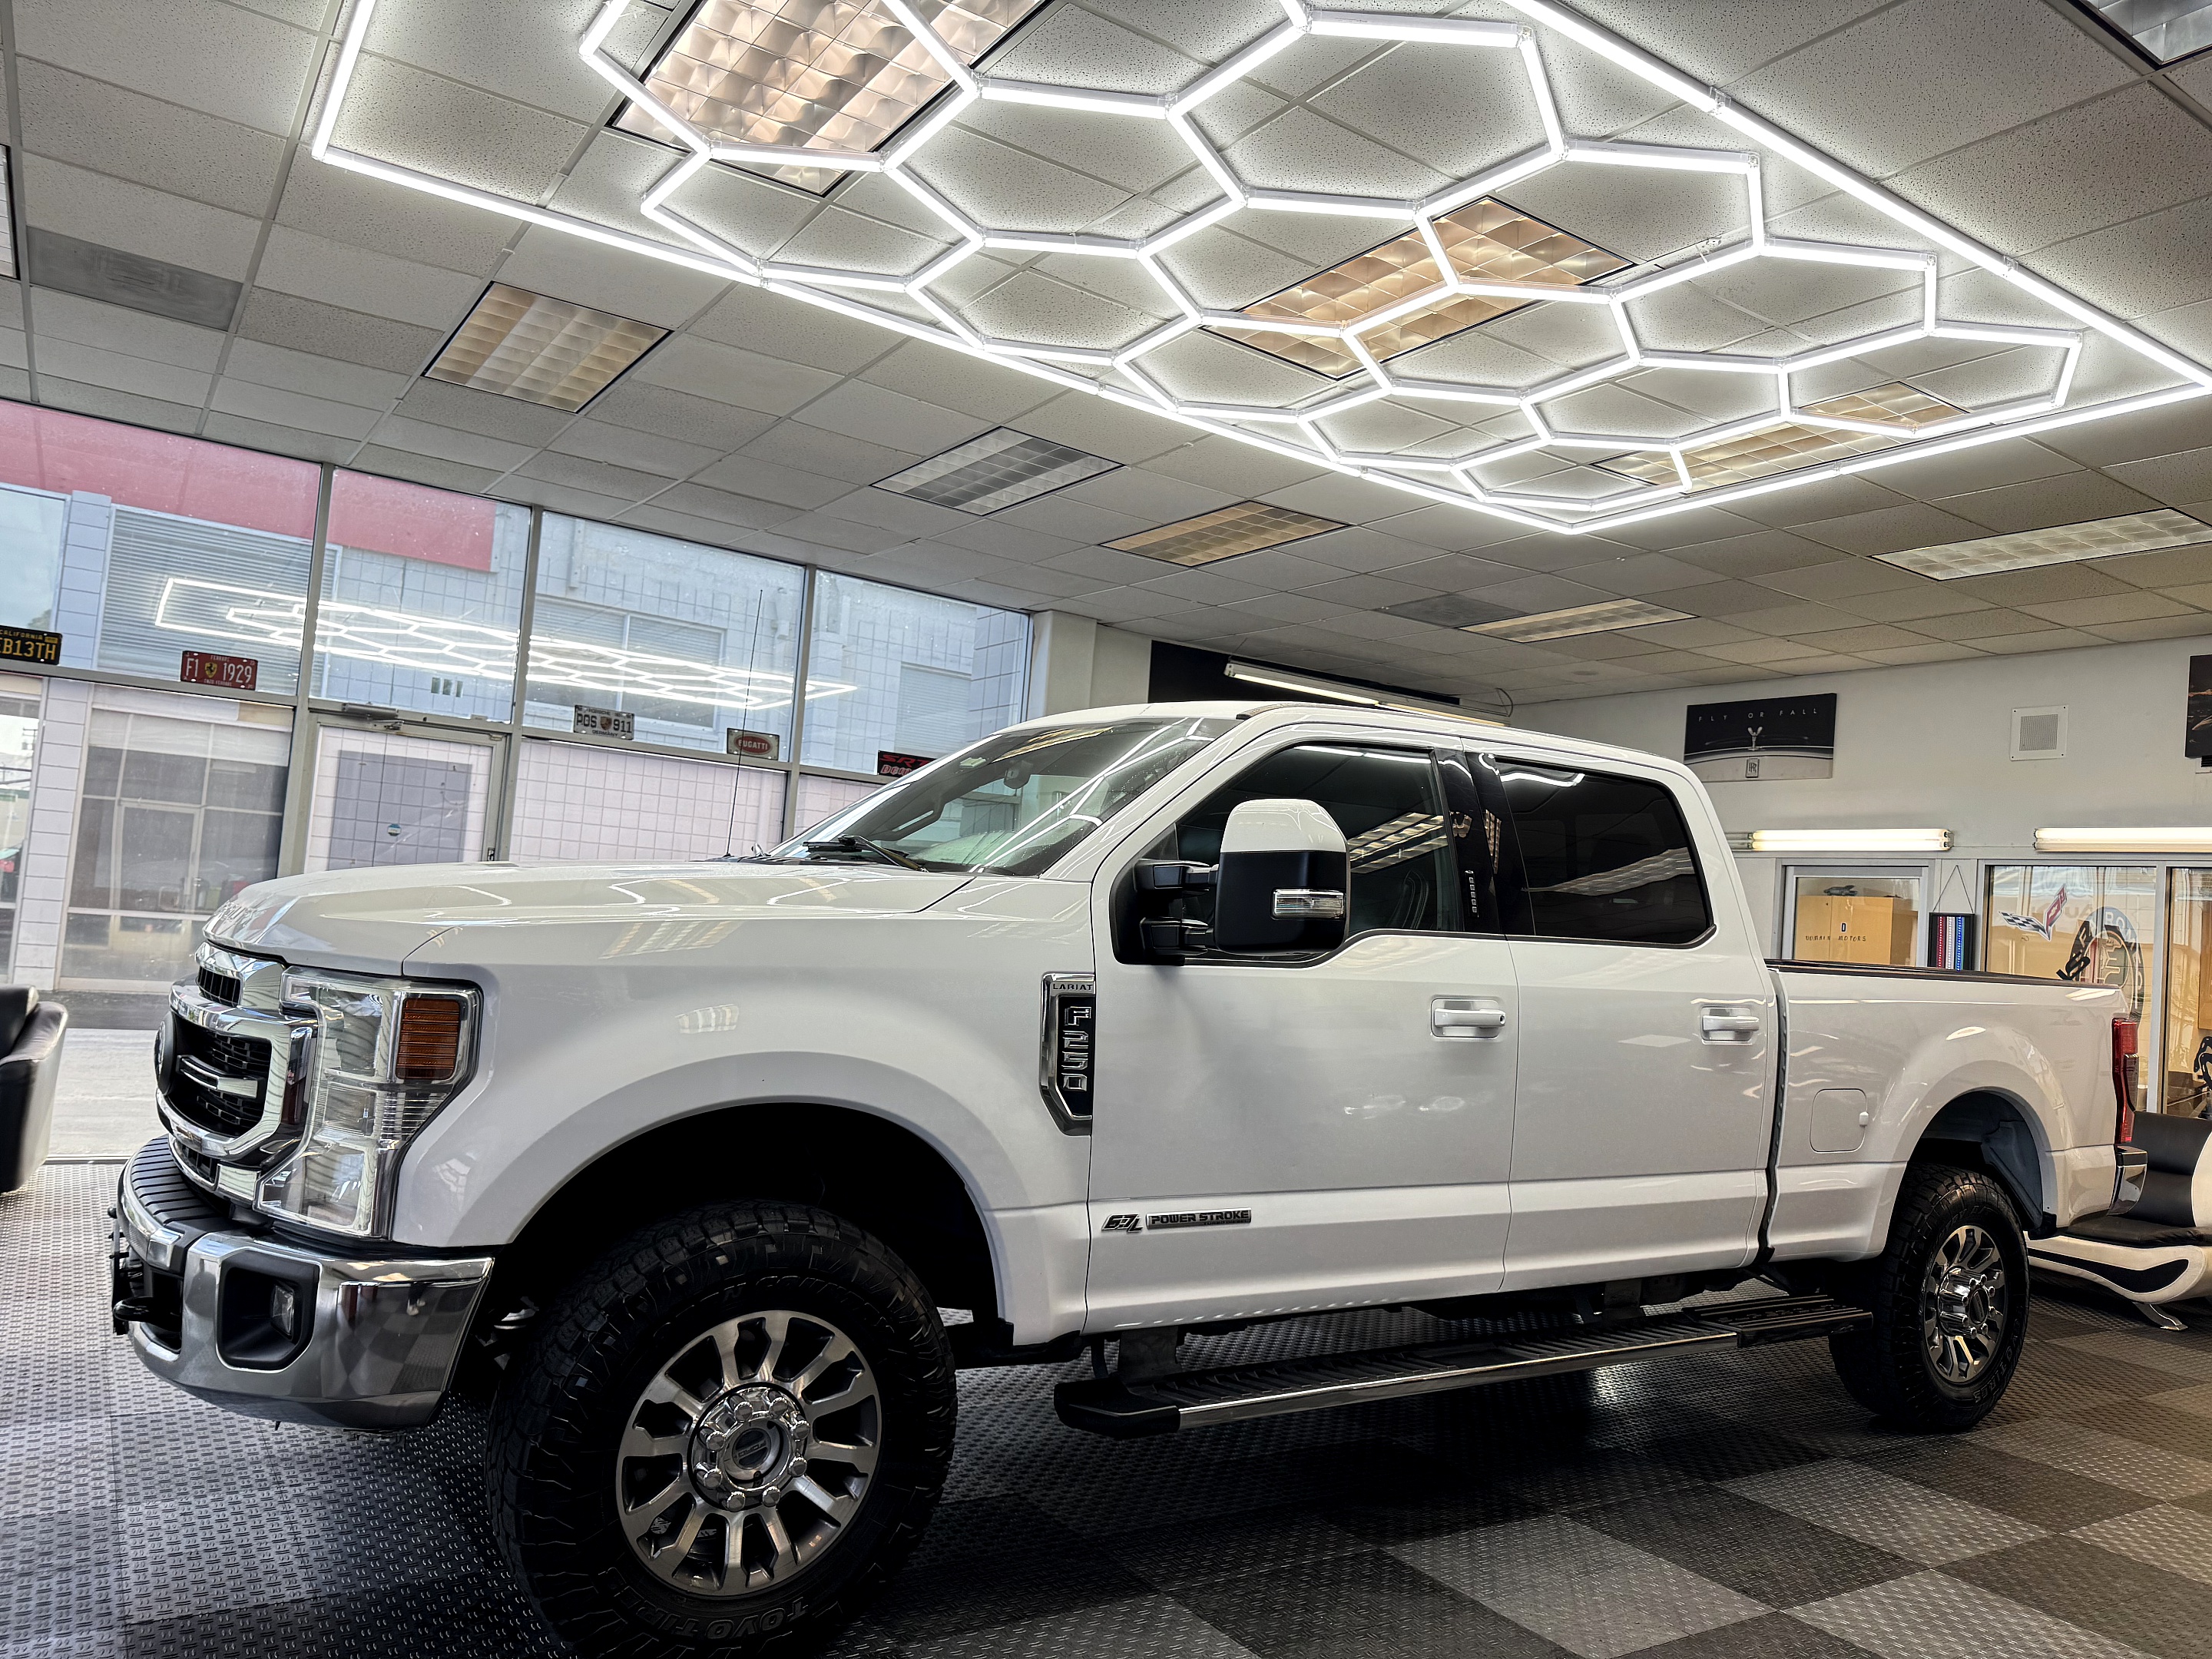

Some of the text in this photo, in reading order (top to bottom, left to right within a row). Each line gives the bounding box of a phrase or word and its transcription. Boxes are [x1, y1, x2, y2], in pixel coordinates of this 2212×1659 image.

[0, 637, 56, 661] B13TH
[186, 657, 253, 684] F1 1929
[1779, 707, 1817, 716] FALL
[613, 719, 632, 733] 911
[1151, 1213, 1197, 1224] POWER
[1199, 1210, 1250, 1221] STROKE
